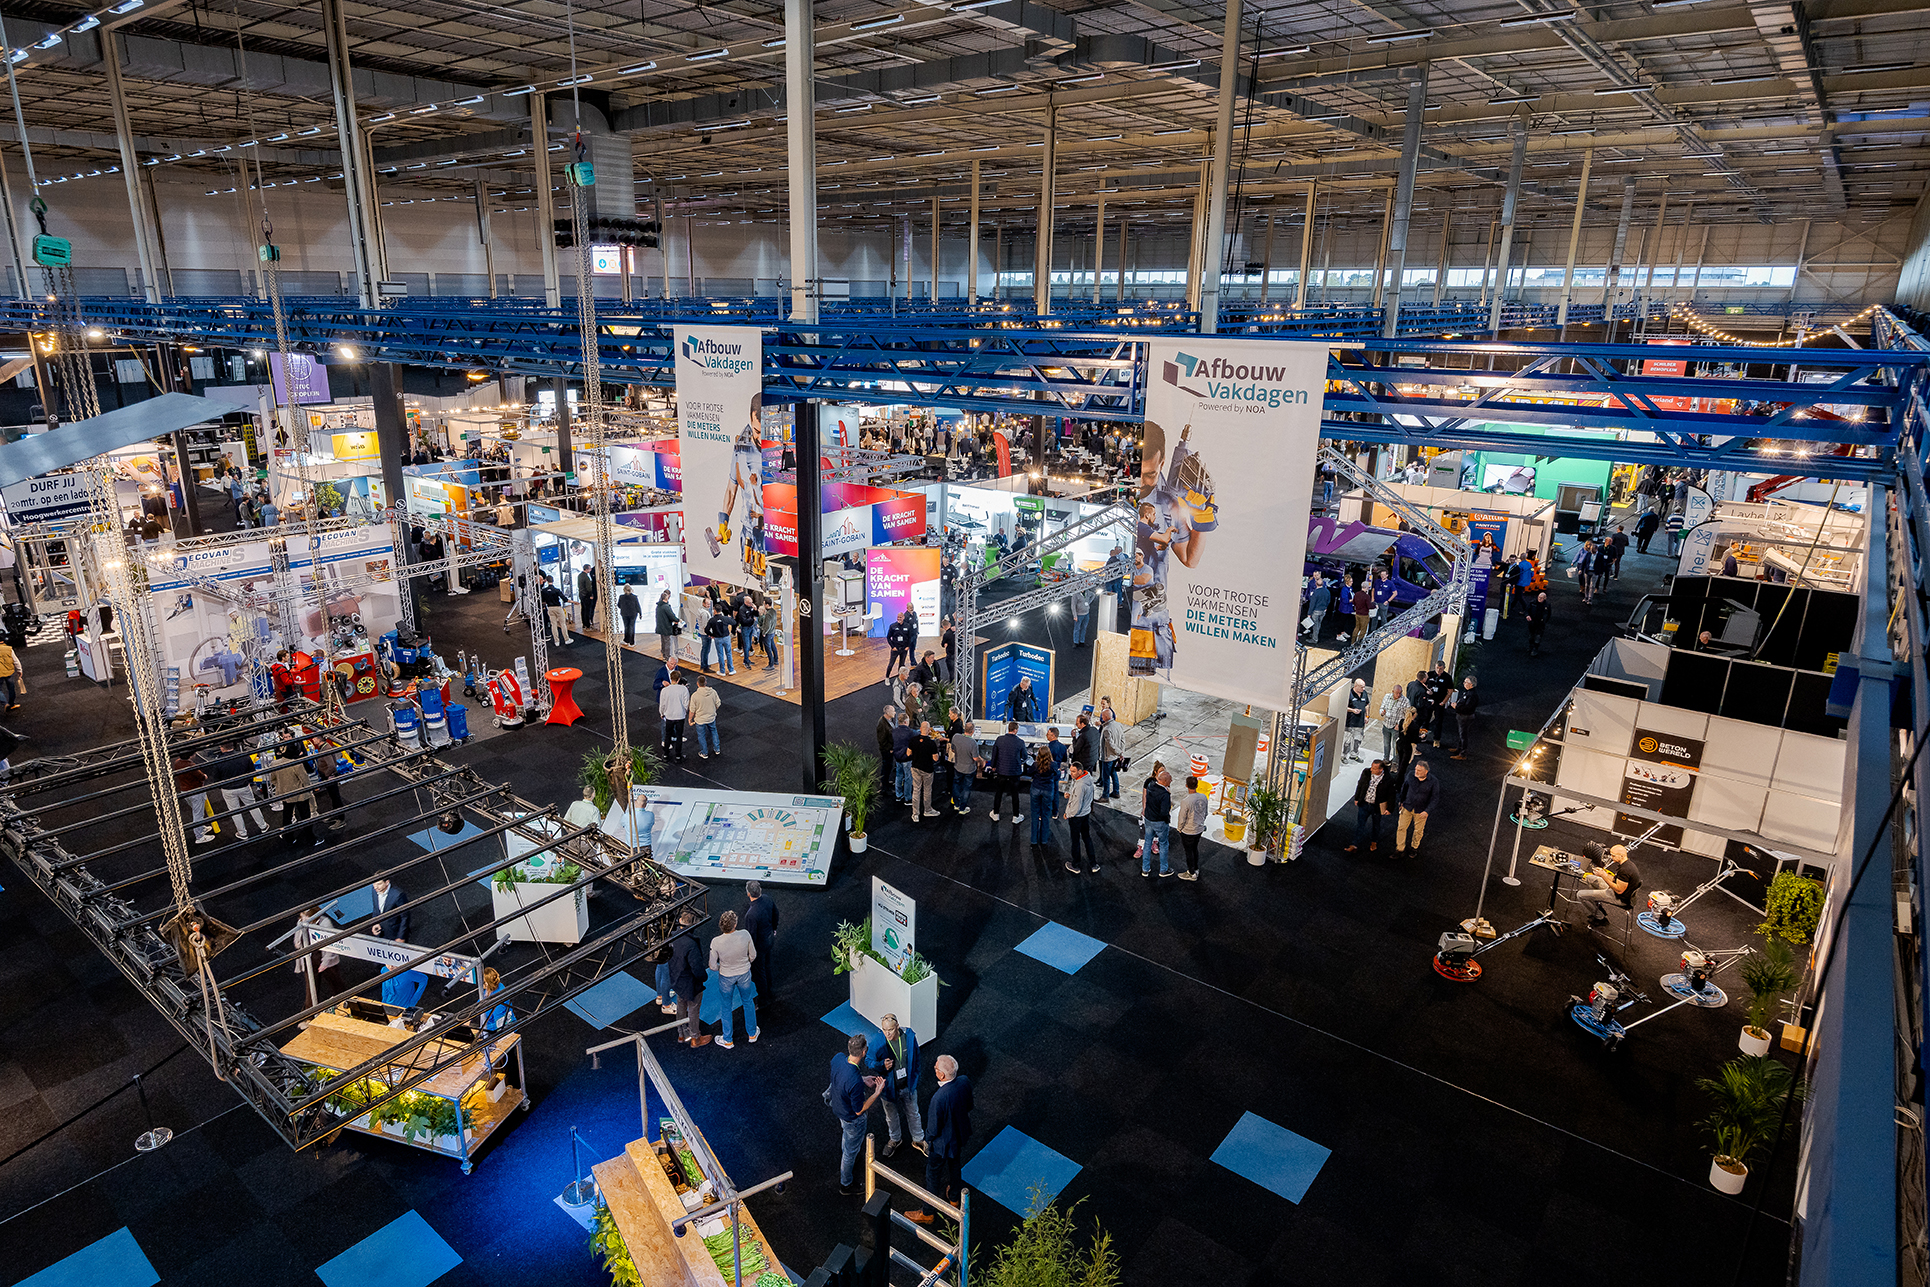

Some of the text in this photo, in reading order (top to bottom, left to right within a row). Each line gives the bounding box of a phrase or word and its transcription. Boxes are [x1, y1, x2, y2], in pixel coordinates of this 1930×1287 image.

[698, 339, 742, 355] Afbouw
[704, 356, 754, 374] Vakdagen
[1194, 357, 1286, 382] Afbouw
[1207, 381, 1308, 408] Vakdagen
[685, 401, 724, 413] VOOR TROTSE
[1198, 402, 1266, 414] Powered by NOA
[686, 410, 720, 422] VAKMENSEN
[687, 420, 721, 432] DIE METERS
[687, 430, 731, 443] WILLEN MAKEN
[30, 478, 76, 493] DURF JIJ
[41, 496, 51, 506] op
[54, 493, 69, 503] een
[882, 510, 916, 522] DE KRACHT
[770, 524, 796, 534] KRACHT
[883, 517, 917, 530] VAN SAMEN
[775, 532, 798, 543] SAMEN
[822, 532, 866, 548] SAINT-GOBAIN
[870, 574, 910, 582] KRACHT
[1188, 583, 1269, 607] VOOR TROTSE
[1187, 596, 1258, 618] VAKMENSEN
[1187, 609, 1257, 631] DIE METERS
[1185, 621, 1276, 648] WILLEN MAKEN
[1019, 650, 1044, 662] Turbodec
[1659, 747, 1691, 758] WERELD
[1660, 742, 1687, 753] BETON
[367, 947, 410, 962] WELKOM
